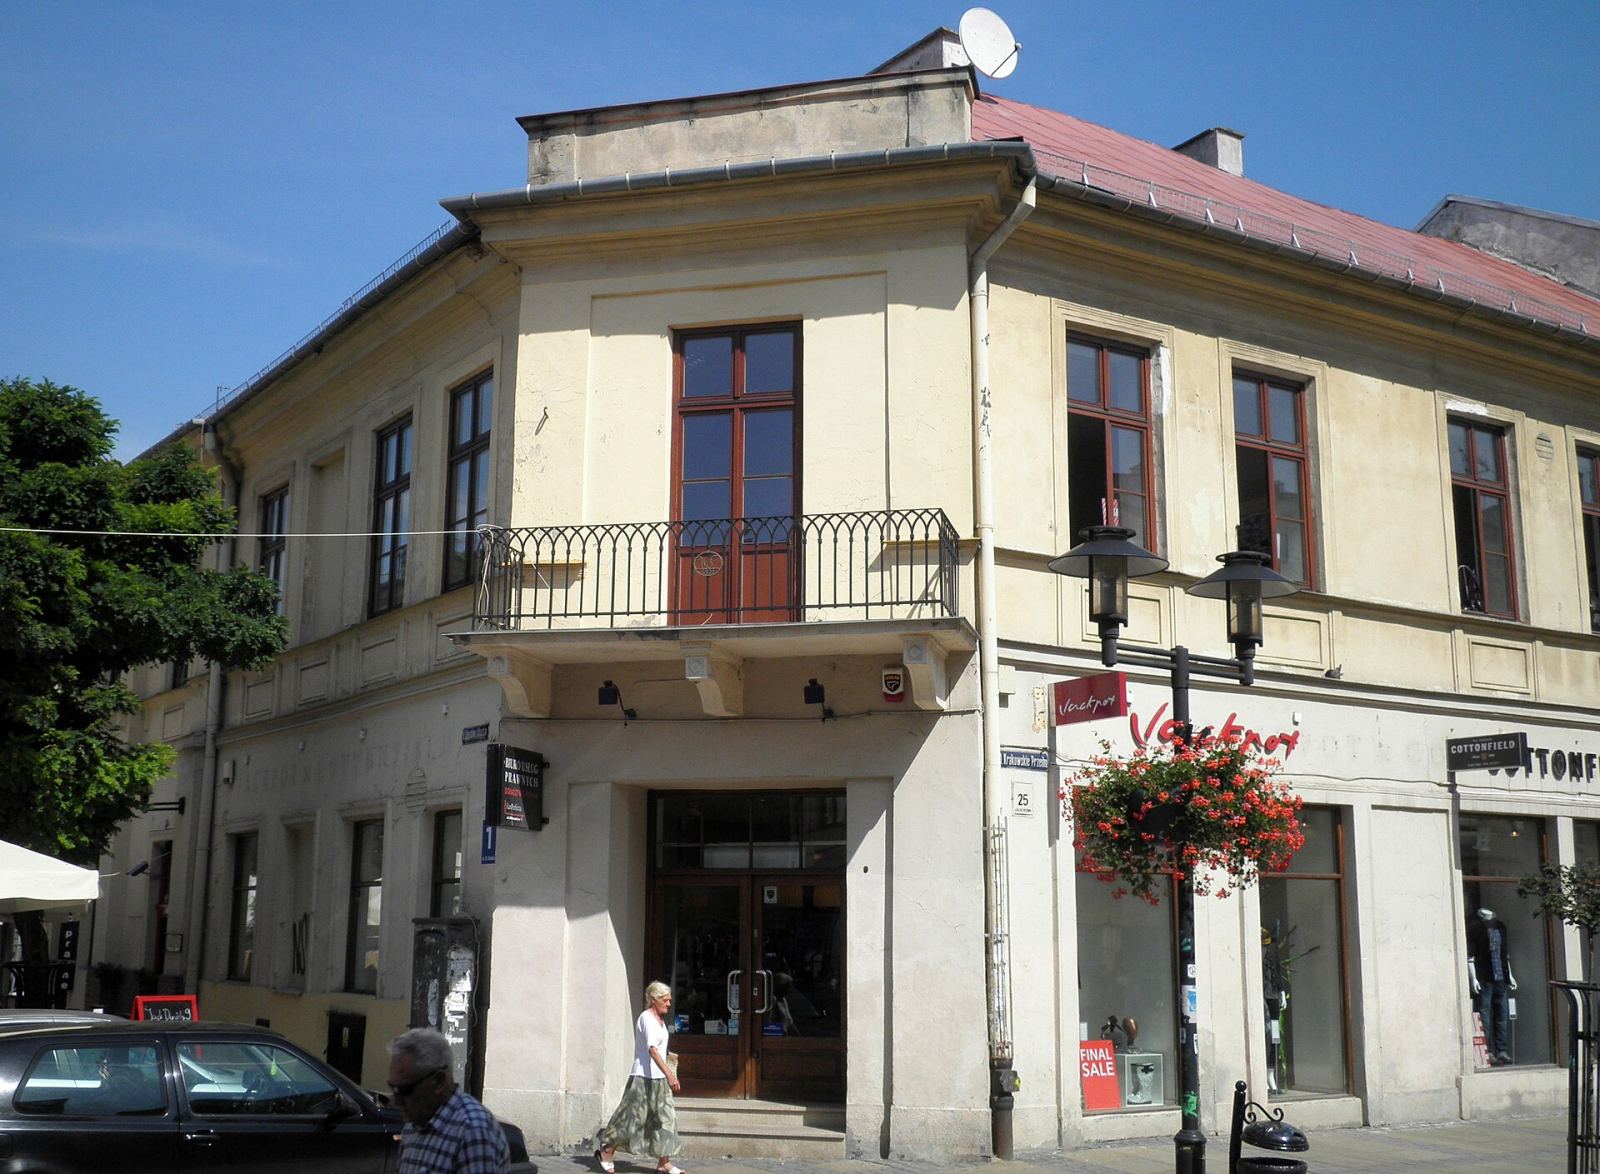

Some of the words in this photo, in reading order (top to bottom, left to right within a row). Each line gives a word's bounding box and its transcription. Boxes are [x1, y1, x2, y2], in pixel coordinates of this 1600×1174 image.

[1451, 740, 1515, 754] COTTONFIELD
[1017, 793, 1029, 806] 25
[485, 826, 492, 849] 1
[1080, 1048, 1113, 1061] FINAL
[1082, 1062, 1115, 1077] SALE
